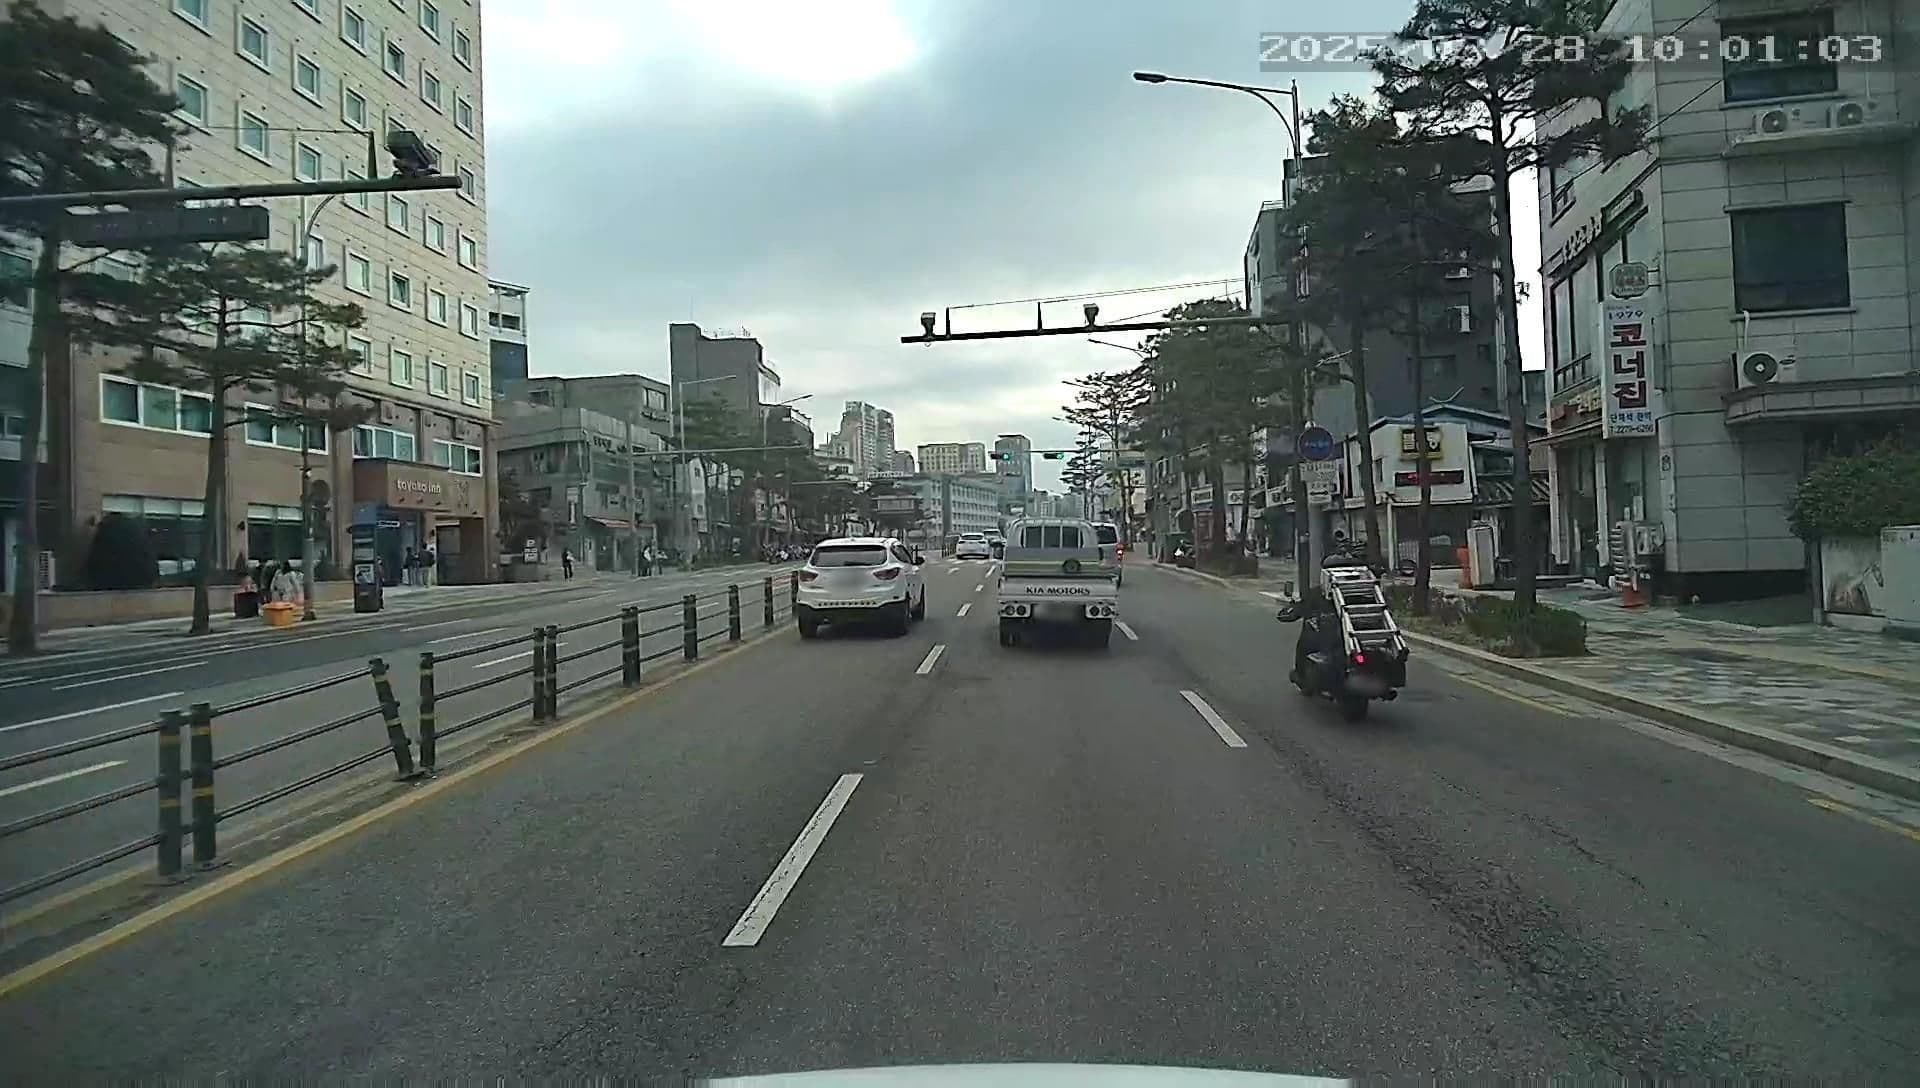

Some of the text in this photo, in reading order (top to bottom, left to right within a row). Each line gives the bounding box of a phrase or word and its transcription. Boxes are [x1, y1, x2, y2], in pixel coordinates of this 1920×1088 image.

[1609, 310, 1644, 320] 1979
[1026, 586, 1090, 595] KIA MOTORS
